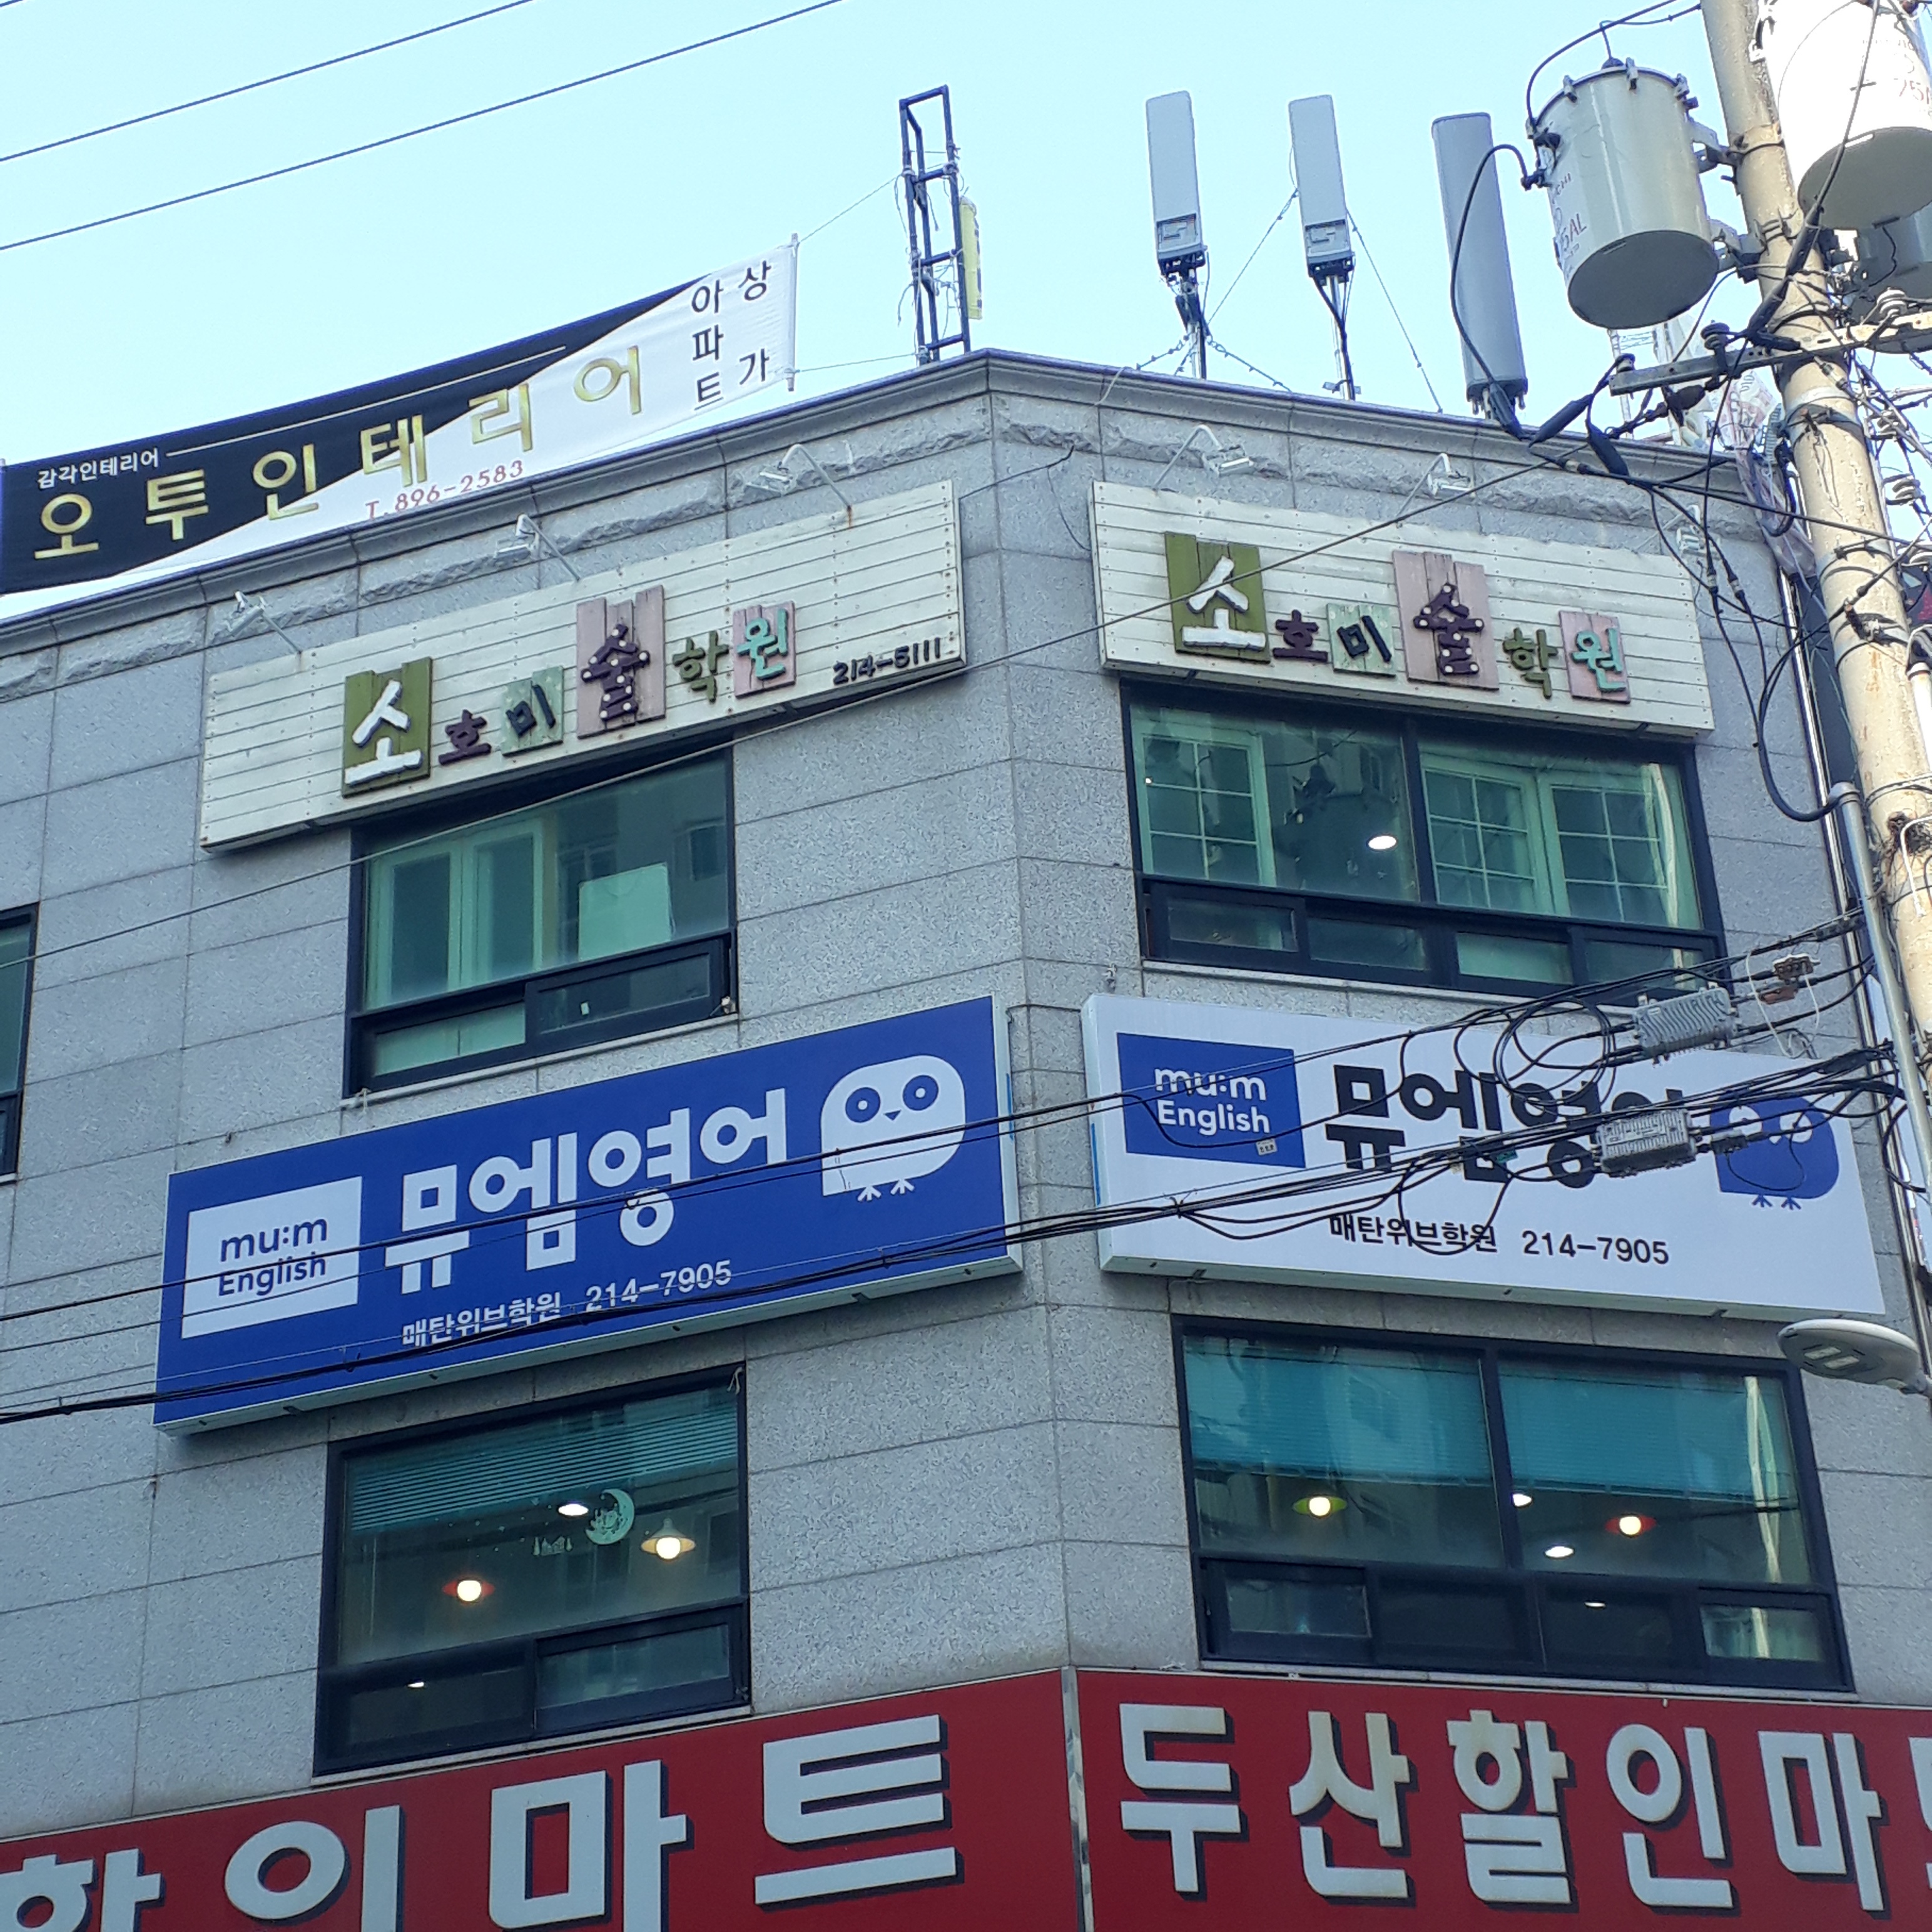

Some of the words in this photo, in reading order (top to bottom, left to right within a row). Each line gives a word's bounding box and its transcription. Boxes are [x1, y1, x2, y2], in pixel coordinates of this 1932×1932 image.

[690, 280, 724, 410] 아파트
[738, 260, 772, 385] 상가
[34, 345, 642, 560] 오투인테리어
[38, 447, 158, 489] 감각인테리어
[833, 636, 942, 686] 214-5111
[1154, 1066, 1267, 1102] mu:m
[1156, 1099, 1271, 1136] English
[385, 1087, 787, 1295] 뮤엠영어
[220, 1218, 328, 1263] mu:m
[1329, 1213, 1498, 1254] 매탄위브학원
[1522, 1229, 1670, 1265] 214-7905
[218, 1251, 326, 1296] English
[402, 1291, 561, 1348] 매탄위브학원
[585, 1259, 733, 1312] 214-7905
[1119, 1709, 1932, 1911] 두산할인마
